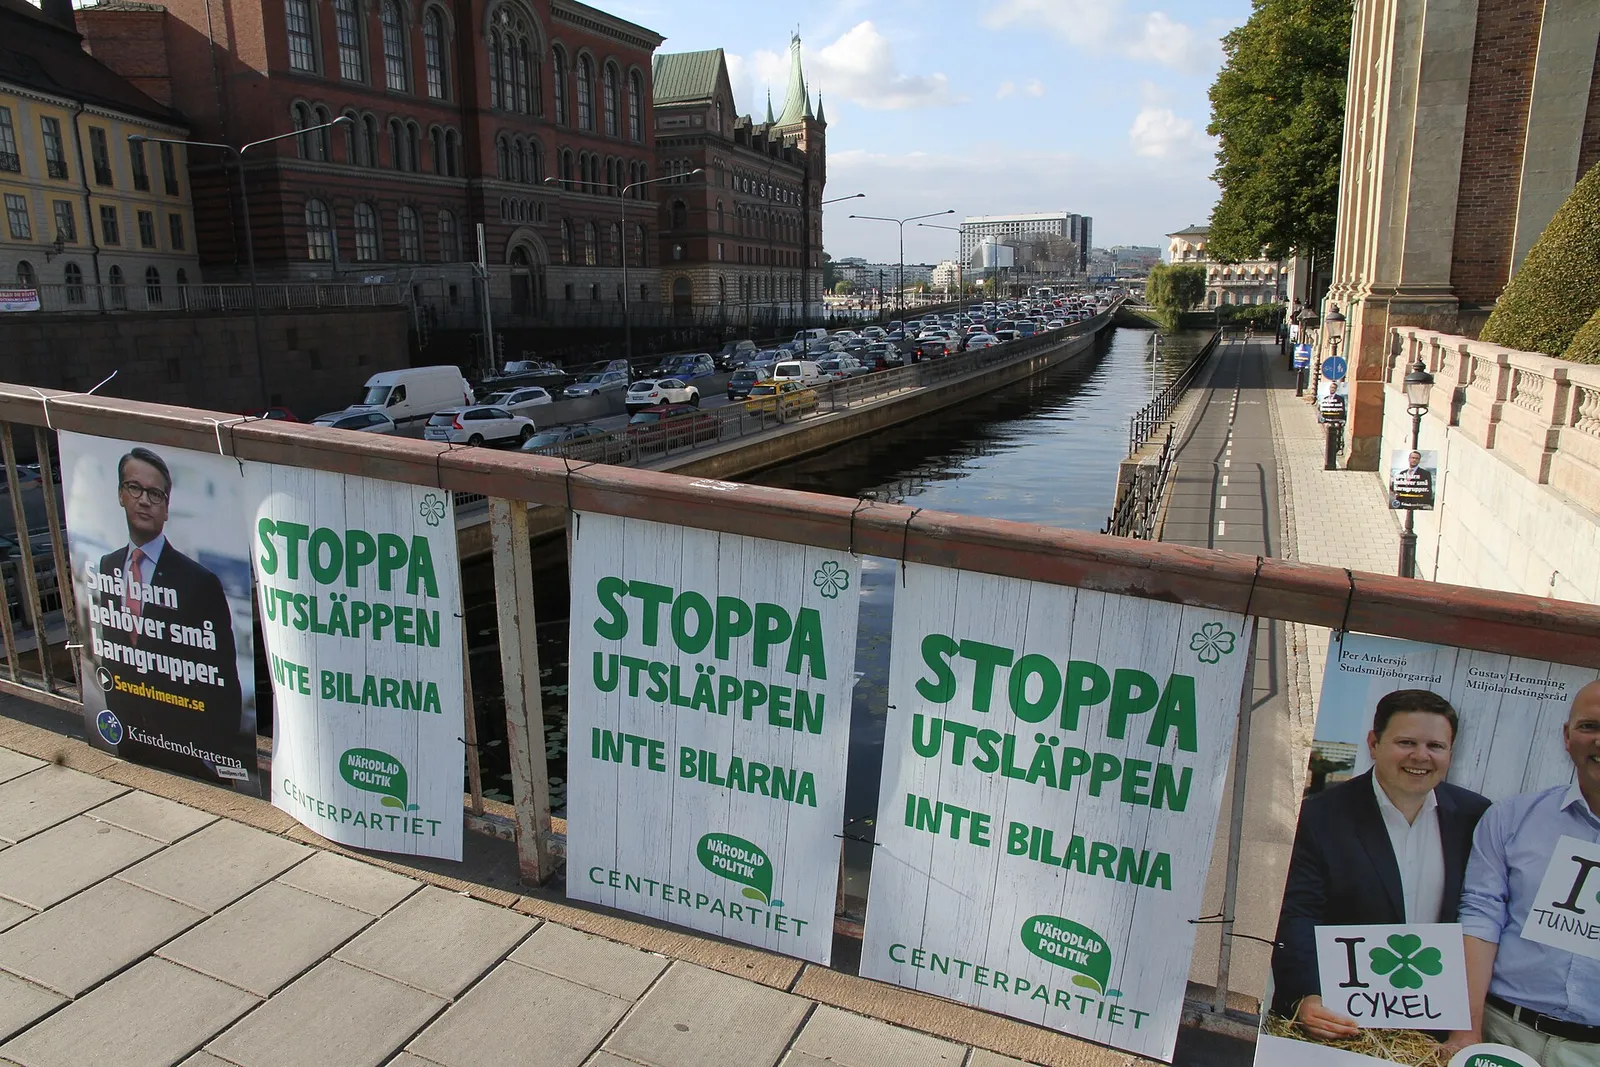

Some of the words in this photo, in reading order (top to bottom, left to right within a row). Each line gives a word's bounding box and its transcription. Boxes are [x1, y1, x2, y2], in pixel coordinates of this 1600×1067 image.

[734, 175, 802, 206] NORSTEDTS
[257, 516, 439, 600] STOPPA
[85, 560, 126, 598] Små
[128, 571, 178, 609] barn
[88, 594, 166, 640] behöver
[170, 620, 216, 650] små
[264, 585, 441, 649] UTSLÄPPEN
[593, 576, 827, 680] STOPPA
[92, 627, 225, 687] barngrupper.
[1339, 663, 1442, 684] Stadsmiljöborgarråd
[1341, 650, 1359, 661] Per
[1361, 653, 1407, 667] Ankersjö
[1468, 667, 1507, 681] Gustav
[1509, 672, 1567, 690] Hemming
[114, 675, 205, 712] Sevadvimenar.se
[272, 653, 311, 697] INTE
[320, 671, 441, 715] BILARNA
[593, 651, 825, 735] UTSLÄPPEN
[914, 633, 1199, 753] STOPPA
[1466, 679, 1568, 702] Miljölandstingsråd
[127, 725, 242, 769] Kristdemokraterna
[347, 753, 400, 776] NÄRODLAD
[591, 727, 666, 773] INTE
[679, 745, 818, 808] BILARNA
[911, 713, 1193, 812] UTSLÄPPEN
[352, 769, 391, 788] POLITIK
[283, 779, 442, 837] CENTERPARTIET
[706, 838, 765, 868] NÄRODLAD
[711, 854, 756, 880] POLITIK
[904, 793, 992, 849] INTE
[1006, 821, 1173, 891] BILARNA
[588, 866, 809, 938] CENTERPARTIET
[1552, 855, 1600, 915] I
[1033, 921, 1102, 954] NÄRODLAD
[1533, 909, 1600, 941] TUNNE
[1038, 937, 1090, 966] POLITIK
[1334, 937, 1370, 988] I
[888, 944, 1150, 1032] CENTERPARTIET
[1346, 991, 1442, 1020] CYKEL
